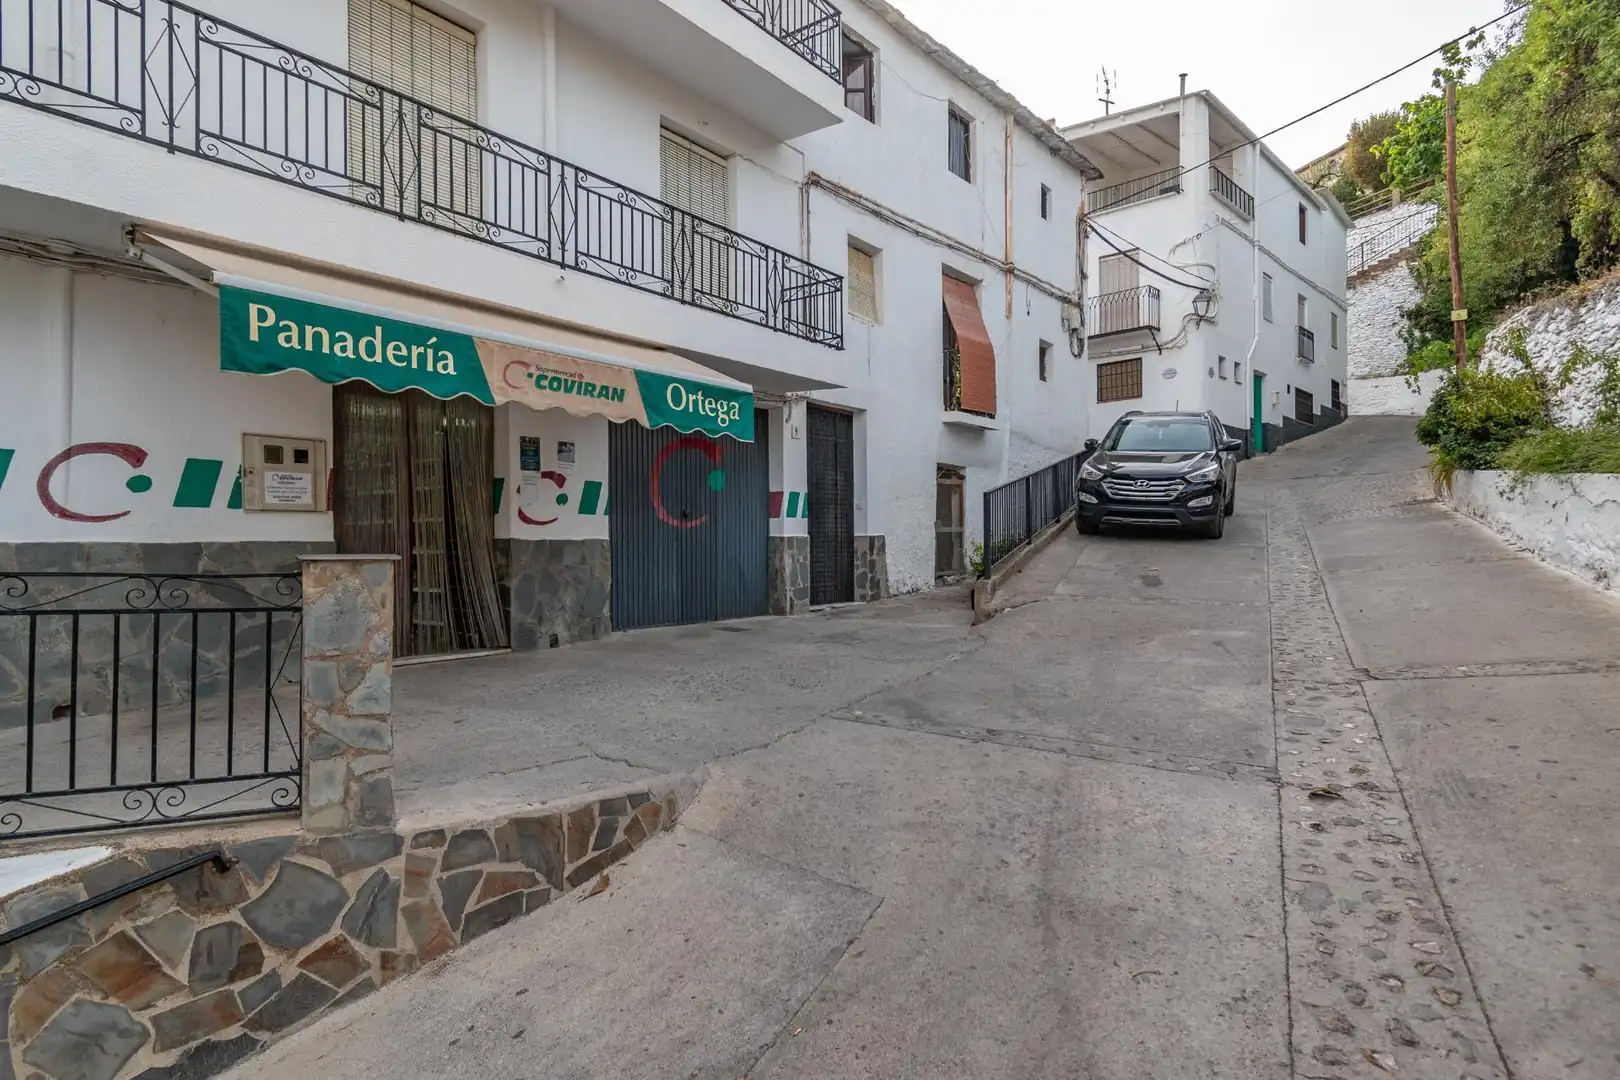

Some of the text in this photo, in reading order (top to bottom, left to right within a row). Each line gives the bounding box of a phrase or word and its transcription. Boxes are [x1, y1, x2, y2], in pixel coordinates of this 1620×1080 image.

[248, 302, 457, 376] Panadería
[535, 373, 626, 402] COVIRAN
[665, 382, 742, 427] Ortega
